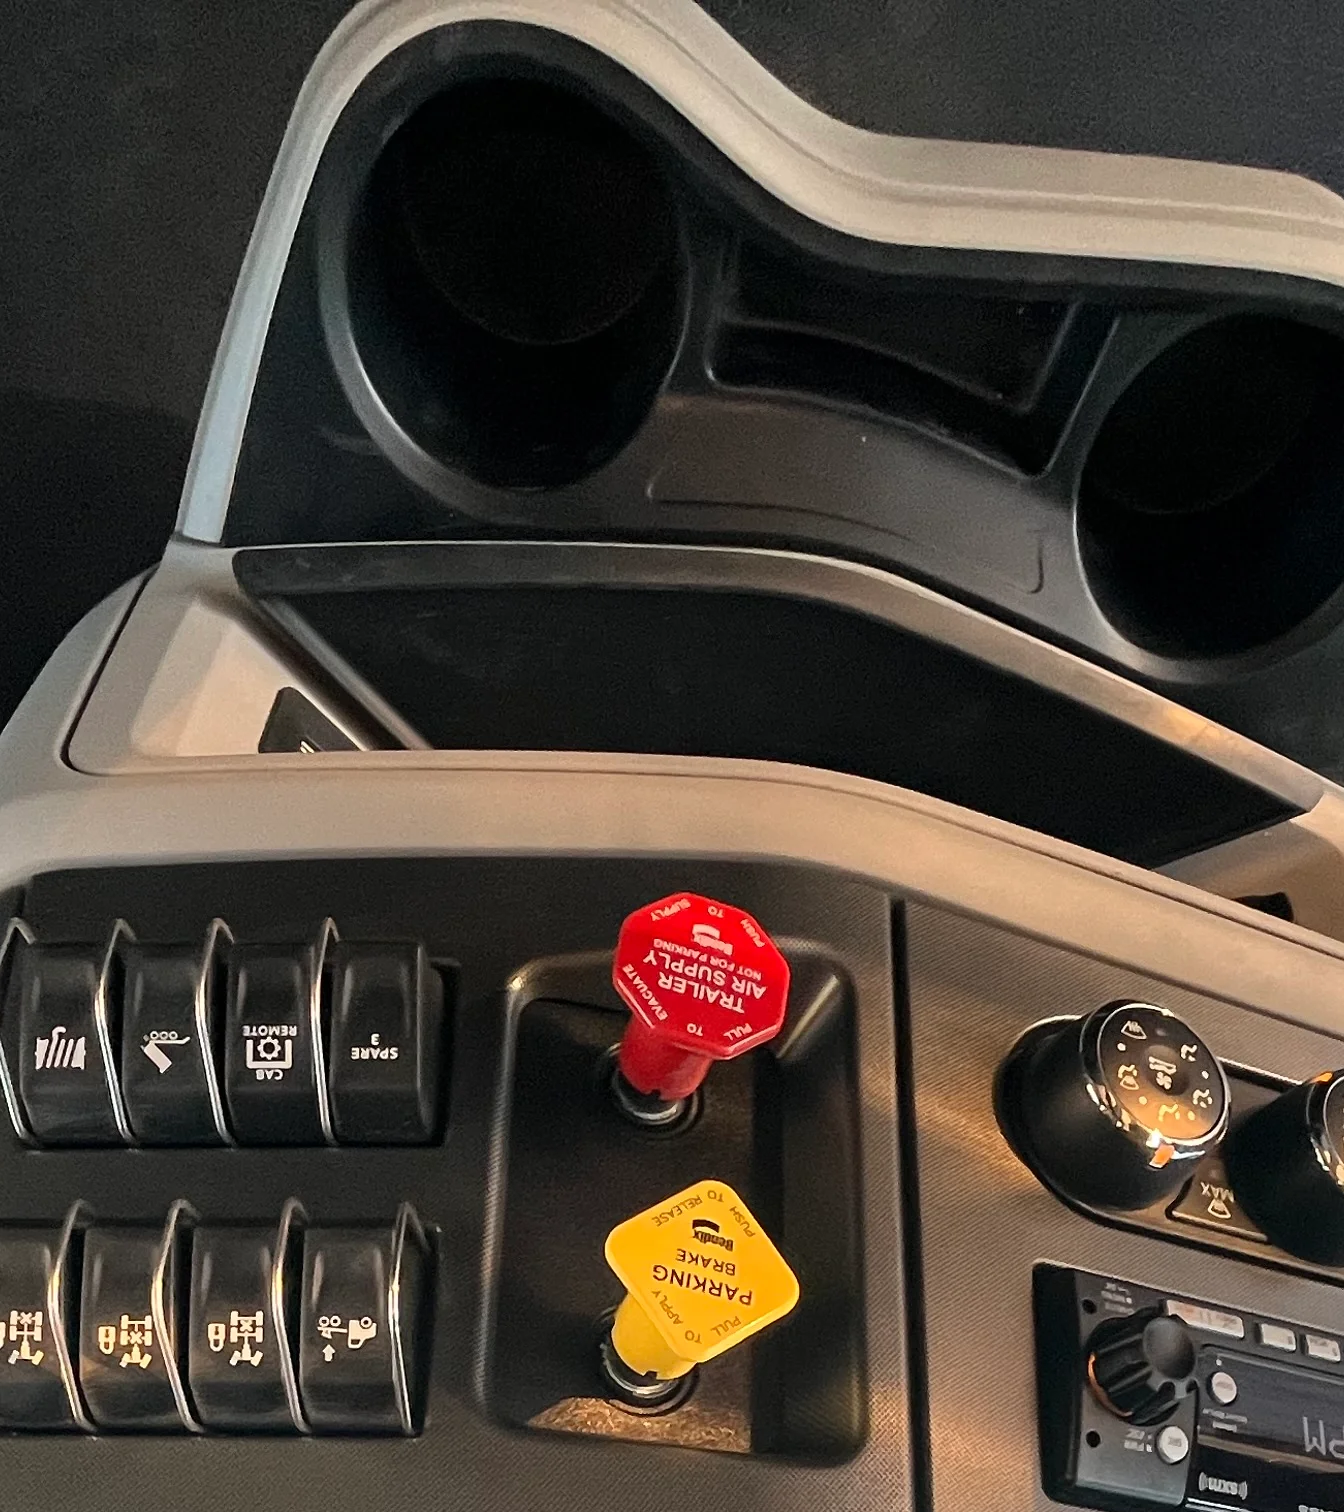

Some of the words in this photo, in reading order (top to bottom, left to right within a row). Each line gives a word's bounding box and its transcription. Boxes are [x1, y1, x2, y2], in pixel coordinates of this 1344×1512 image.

[649, 897, 691, 922] SUPPLY
[707, 905, 724, 919] TO
[739, 918, 766, 948] PUSH
[653, 938, 708, 964] PARKING
[642, 949, 727, 987] SUPPLY
[709, 954, 736, 972] FOR
[736, 964, 762, 981] NOT
[621, 962, 669, 1021] EVACUATE
[657, 971, 745, 1014] TRAILER
[730, 975, 767, 1000] AIR
[241, 1025, 298, 1037] REMOTE
[370, 1033, 380, 1046] 3
[686, 1023, 704, 1037] TO
[722, 1022, 753, 1041] PULL
[350, 1046, 399, 1060] SPARE
[255, 1068, 284, 1081] CAB
[707, 1189, 724, 1203] TO
[1200, 1181, 1235, 1203] MAX
[650, 1194, 703, 1227] RELEASE
[729, 1205, 756, 1238] PUSH
[691, 1229, 734, 1252] Bendix
[674, 1248, 736, 1276] BRAKE
[652, 1264, 753, 1306] PARKING
[650, 1288, 683, 1326] APPLY
[709, 1315, 742, 1337] PULL
[684, 1330, 702, 1345] TO
